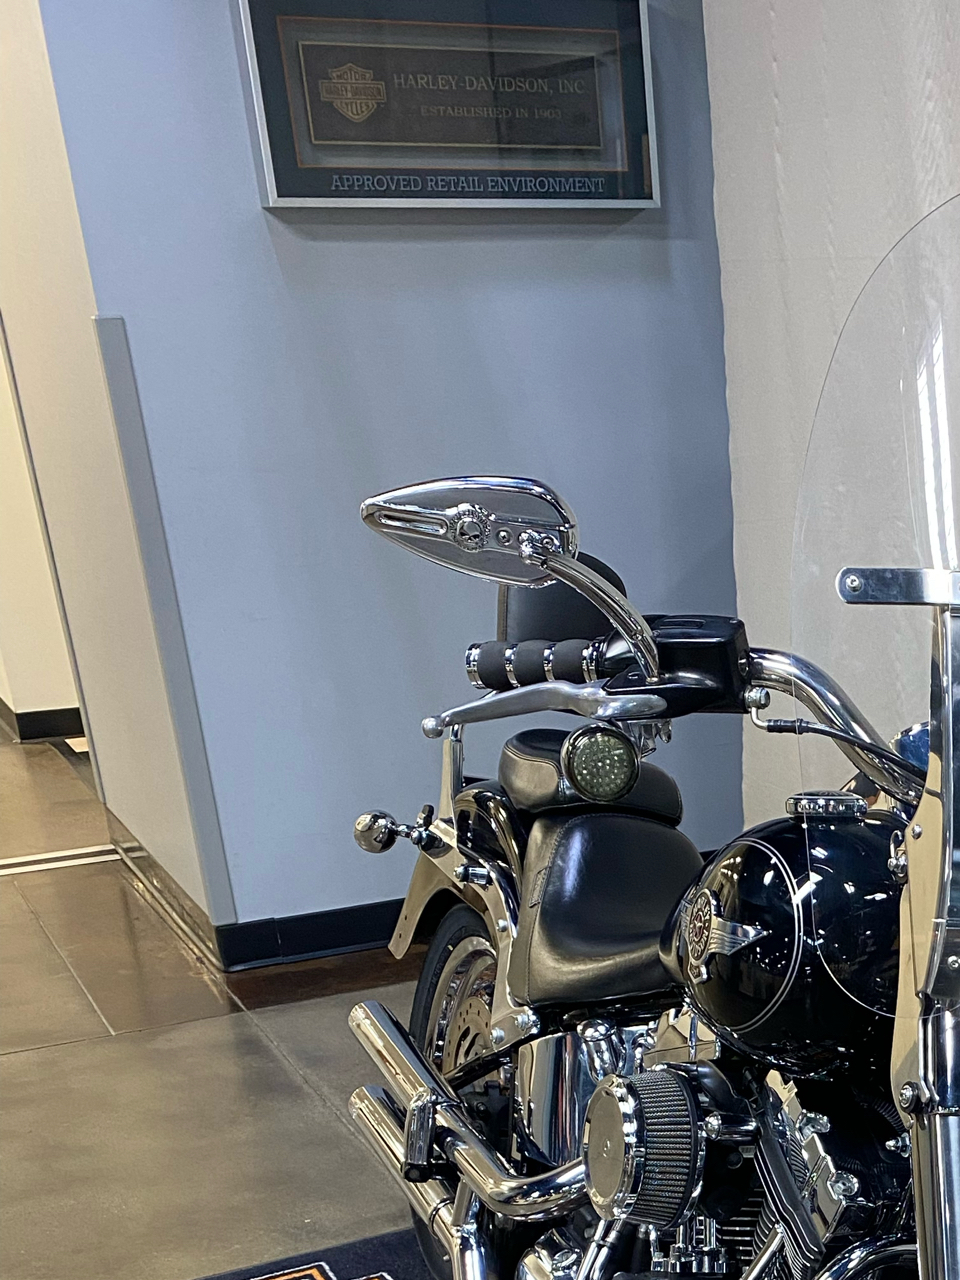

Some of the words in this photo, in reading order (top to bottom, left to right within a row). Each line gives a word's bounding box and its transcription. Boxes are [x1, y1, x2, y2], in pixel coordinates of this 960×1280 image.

[339, 101, 370, 116] CYCLES
[420, 105, 512, 118] ESTABLISHED
[515, 107, 529, 118] IN
[534, 108, 562, 119] 1903
[330, 175, 423, 192] APPROVED
[426, 176, 484, 192] RETAIL
[487, 177, 605, 193] ENVIRONMENT
